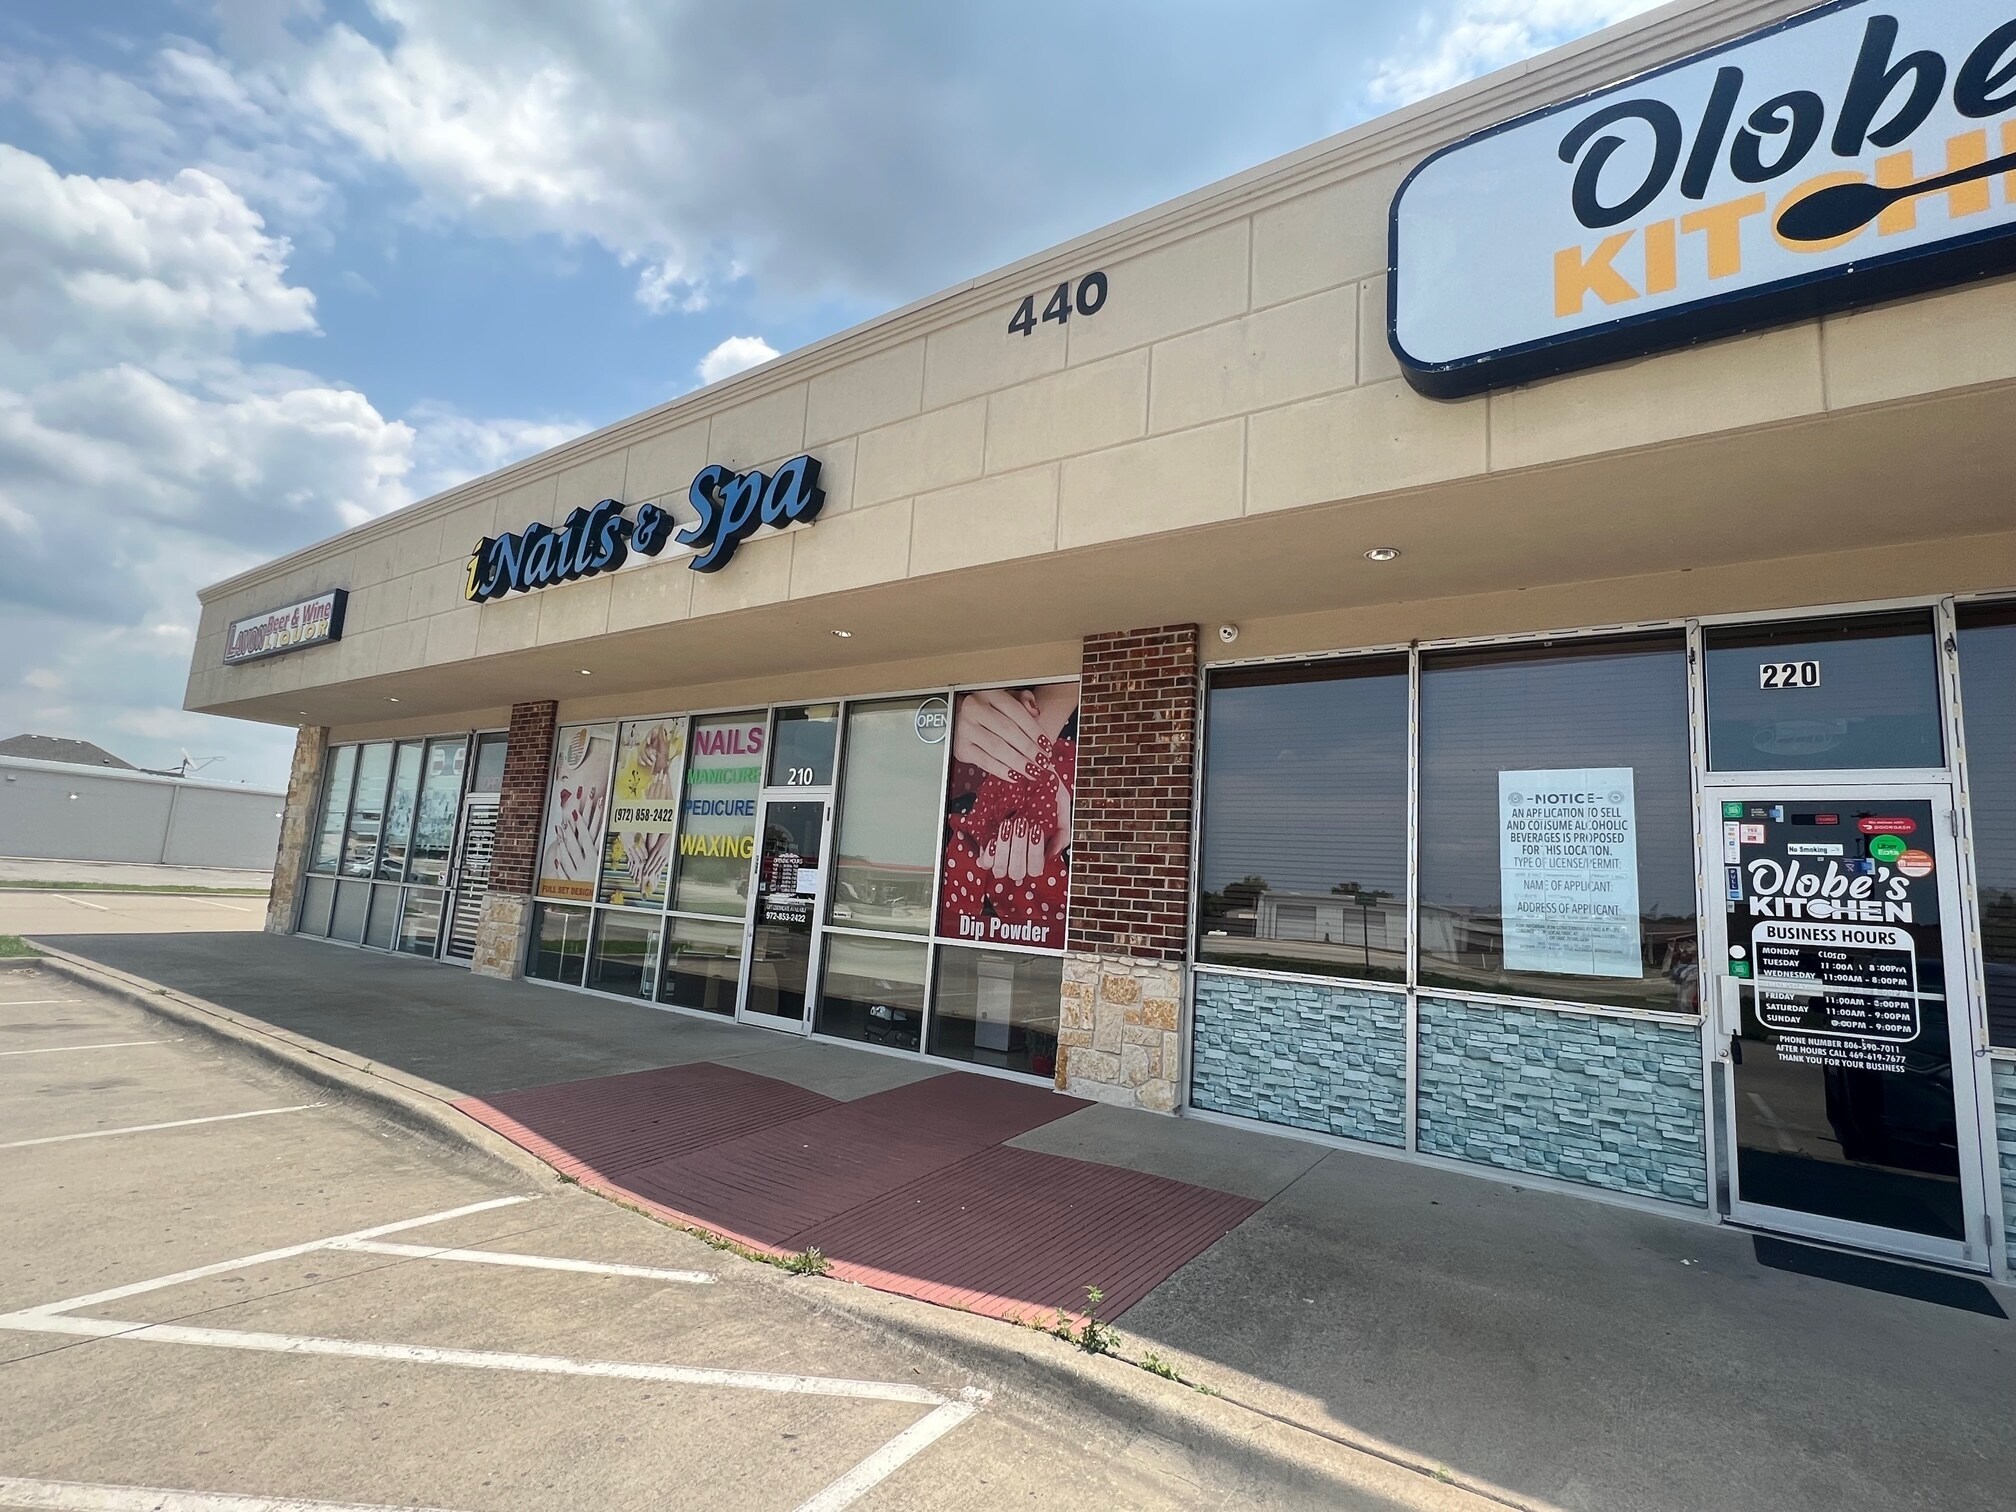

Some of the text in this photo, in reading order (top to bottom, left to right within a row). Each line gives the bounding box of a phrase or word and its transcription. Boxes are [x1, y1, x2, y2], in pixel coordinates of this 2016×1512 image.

[1554, 120, 2016, 317] KITCH
[1008, 271, 1107, 336] 440
[631, 503, 674, 556] &
[675, 455, 826, 573] Spa
[267, 602, 331, 634] Beer & Wine
[264, 619, 328, 650] LIQUOR
[1762, 662, 1817, 688] 220
[917, 713, 948, 727] OPEN
[694, 727, 764, 756] NAILS
[687, 767, 762, 784] MANICURE
[787, 768, 813, 785] 210
[614, 808, 673, 823] (972) 858-2422
[685, 799, 755, 816] PEDICURE
[1512, 808, 1621, 818] AN APPLICATION TO SELL
[1507, 820, 1628, 830] AND CONSUME ALCOHOLIC
[680, 834, 754, 859] WAXING
[1511, 833, 1624, 843] BEVERAGES IS PROPOSED
[1522, 845, 1539, 855] FOR
[1800, 846, 1828, 854] Smoking
[1514, 857, 1533, 867] TYPE
[1535, 858, 1547, 868] OF
[1524, 880, 1548, 890] NAME
[1551, 880, 1560, 891] OF
[1748, 859, 1910, 900] Olobe's
[542, 885, 593, 896] FULL SET DESIGN
[1517, 902, 1557, 913] ADDRESS
[1559, 902, 1570, 914] OF
[1750, 896, 1912, 923] KITCHEN
[959, 914, 1050, 943] Dip Powder
[1767, 926, 1896, 945] BUSINESS HOURS
[1762, 947, 1799, 955] MONDAY
[1763, 958, 1799, 967] TUESDAY
[1764, 970, 1815, 979] WEDNESDAY
[1823, 973, 1863, 982] 11:00AM
[1872, 977, 1907, 985] 8:00PM
[1765, 992, 1795, 1001] FRIDAY
[1825, 997, 1864, 1006] 11:00AM
[1766, 1003, 1809, 1013] SATURDAY
[1826, 1008, 1865, 1017] 11:00AM
[1875, 1012, 1910, 1021] 9:00PM
[1767, 1015, 1801, 1024] SUNDAY
[1876, 1024, 1912, 1033] 9:00PM
[1779, 1035, 1806, 1045] PHONE
[1808, 1038, 1842, 1048] NUMBER
[1776, 1044, 1799, 1053] AFTER
[1800, 1046, 1827, 1056] HOURS
[1829, 1049, 1847, 1058] CALL
[1778, 1053, 1905, 1073] THANK YOU FOR YOUR BUSINESS
